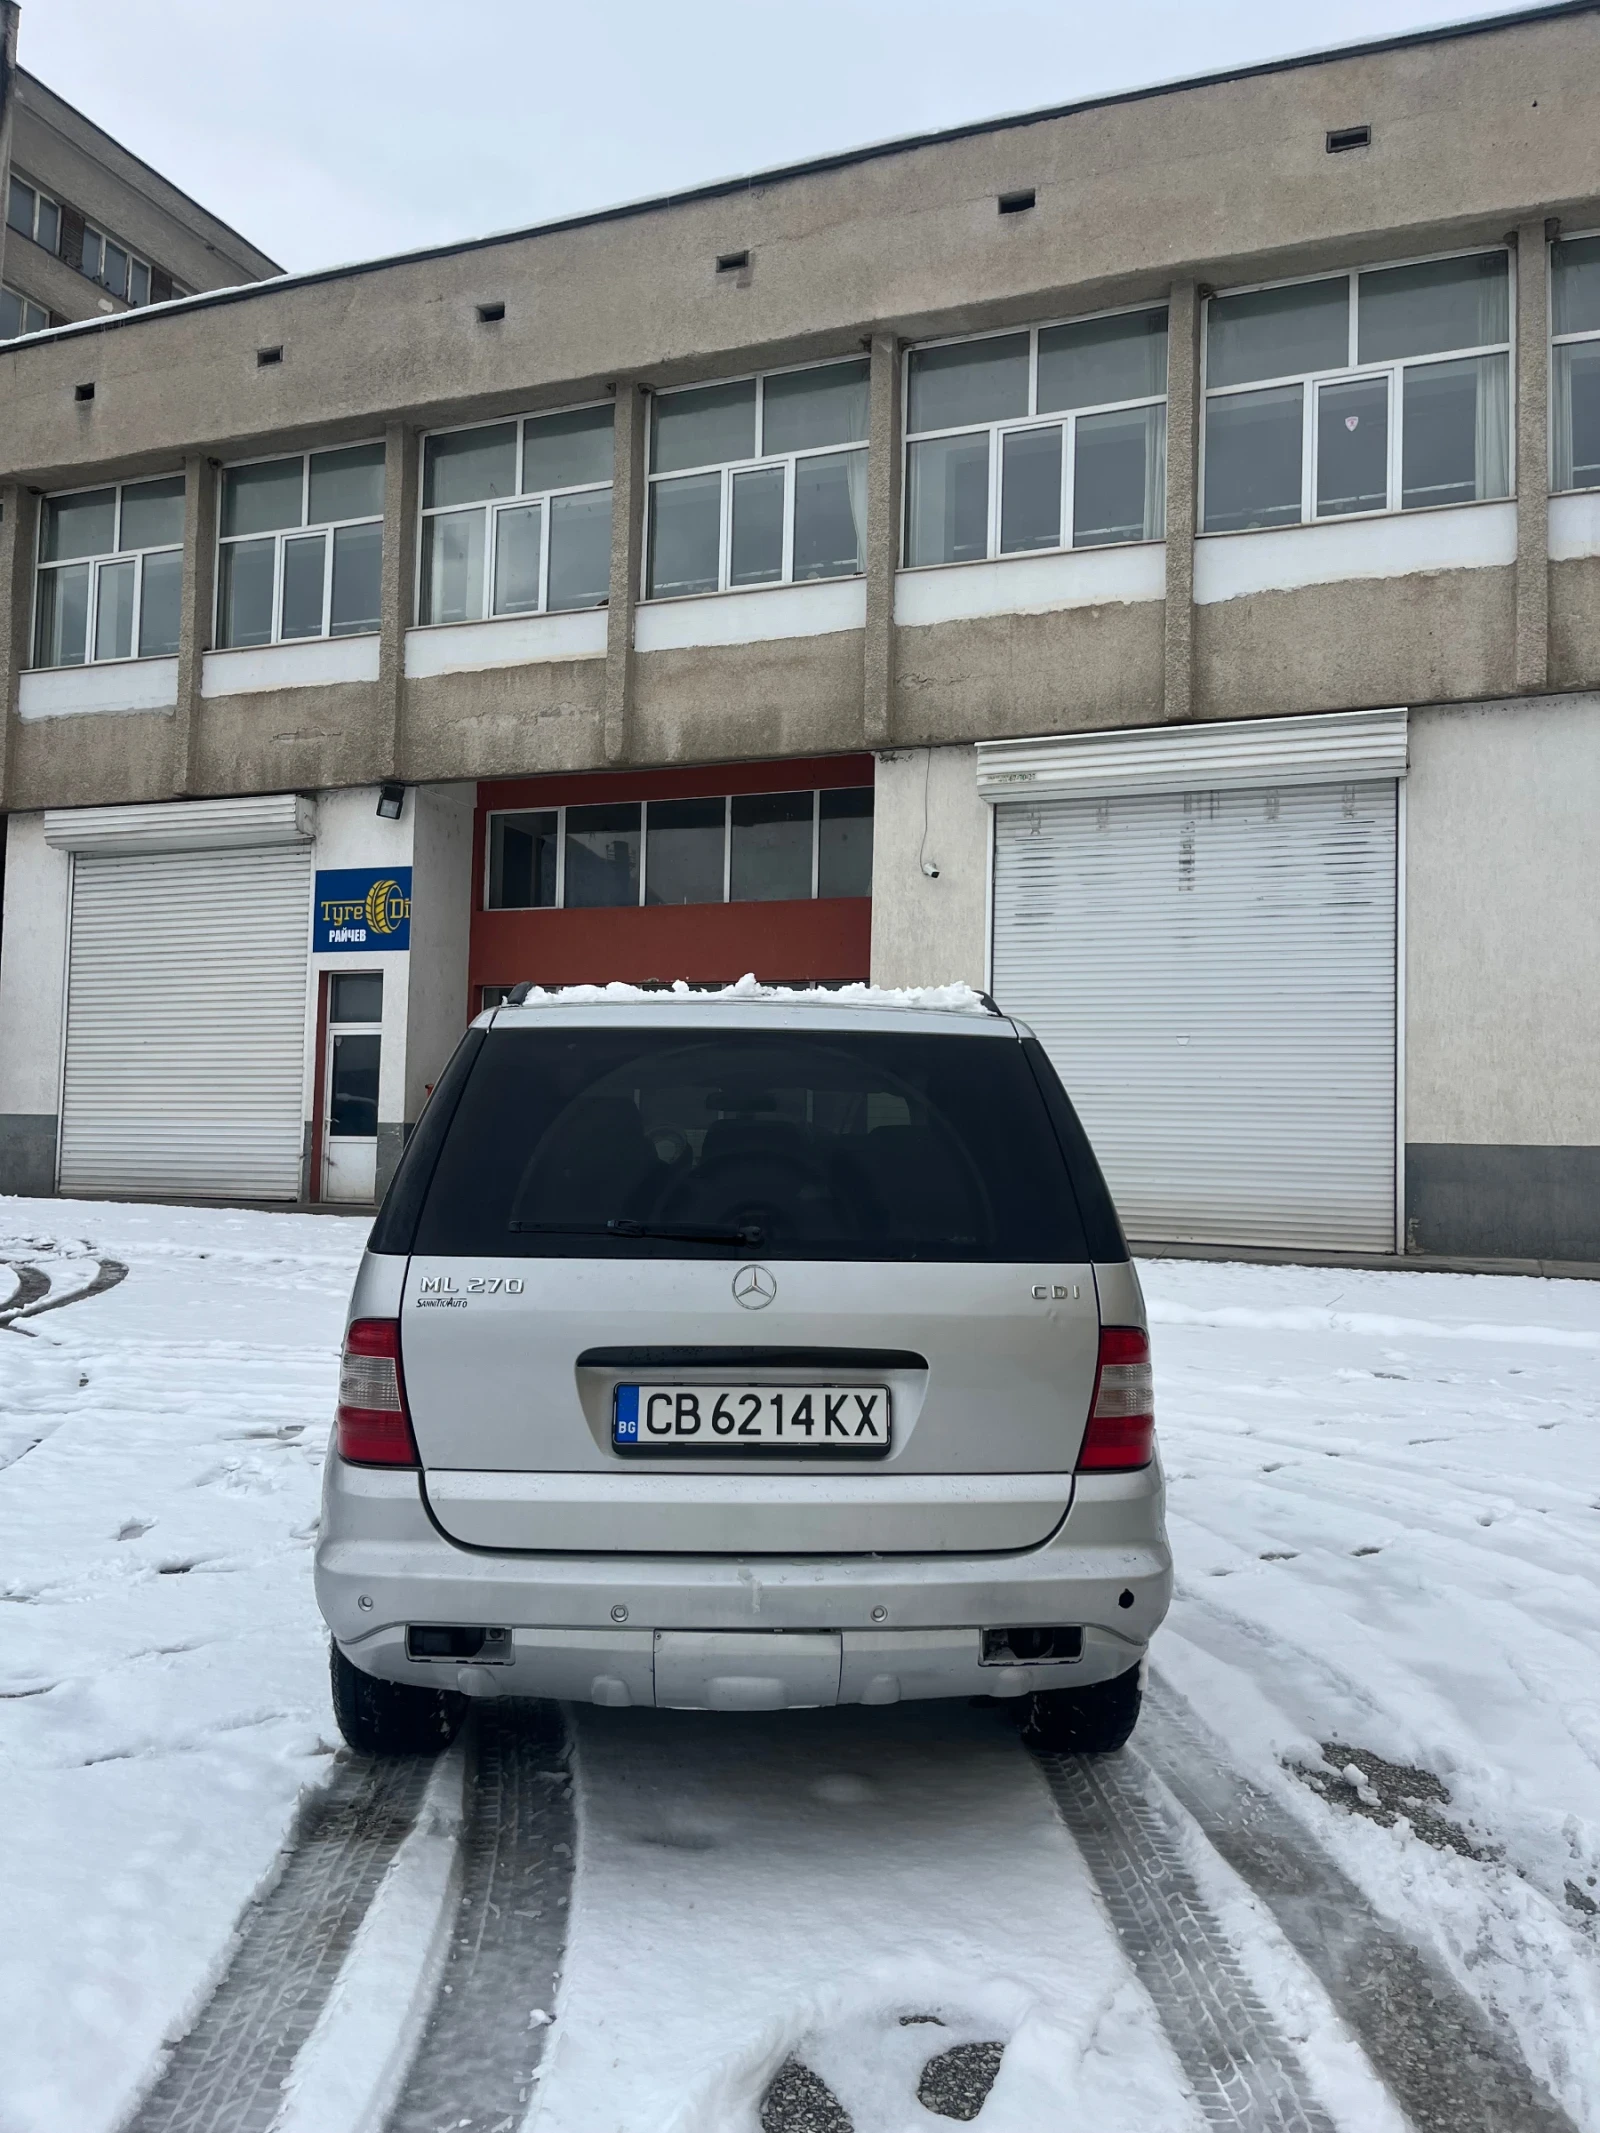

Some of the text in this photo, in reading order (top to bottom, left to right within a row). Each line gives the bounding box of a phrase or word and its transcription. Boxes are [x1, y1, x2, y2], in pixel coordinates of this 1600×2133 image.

[321, 900, 365, 926] Tyre
[328, 927, 367, 943] РАЙЧЕВ
[420, 1276, 525, 1294] ML 270
[1031, 1284, 1080, 1300] CDI
[618, 1421, 636, 1434] BG
